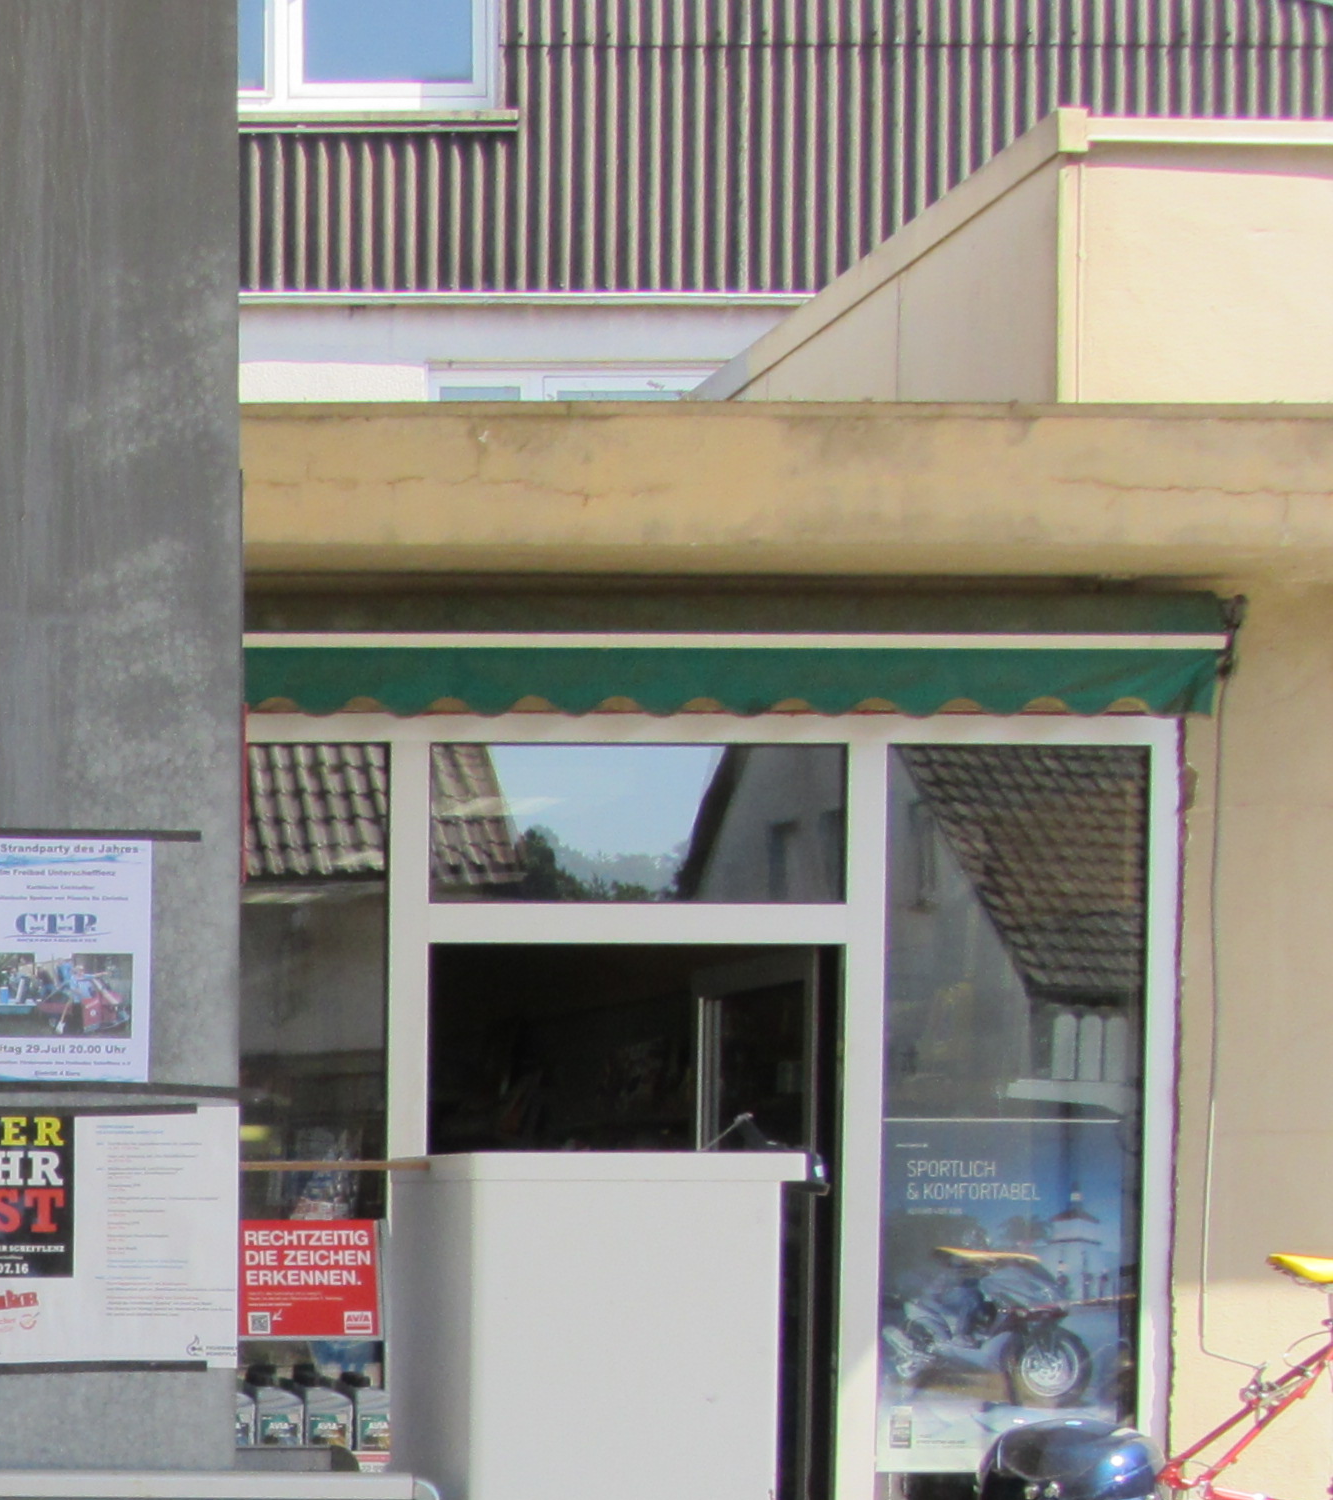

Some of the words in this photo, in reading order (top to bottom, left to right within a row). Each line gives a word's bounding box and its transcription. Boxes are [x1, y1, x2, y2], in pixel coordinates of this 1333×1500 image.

[0, 843, 70, 855] Strandparty
[73, 844, 94, 853] des
[98, 844, 139, 854] Jahres
[69, 1044, 102, 1054] 20.00
[105, 1044, 127, 1054] Uhr
[907, 1160, 996, 1177] SPORTLICH
[907, 1182, 919, 1200] &
[923, 1182, 1041, 1200] KOMFORTABEL
[244, 1230, 369, 1247] RECHTZEITIG
[244, 1250, 278, 1266] DIE
[283, 1250, 371, 1266] ZEICHEN
[245, 1270, 361, 1286] ERKENNEN.
[346, 1313, 371, 1322] AVIA
